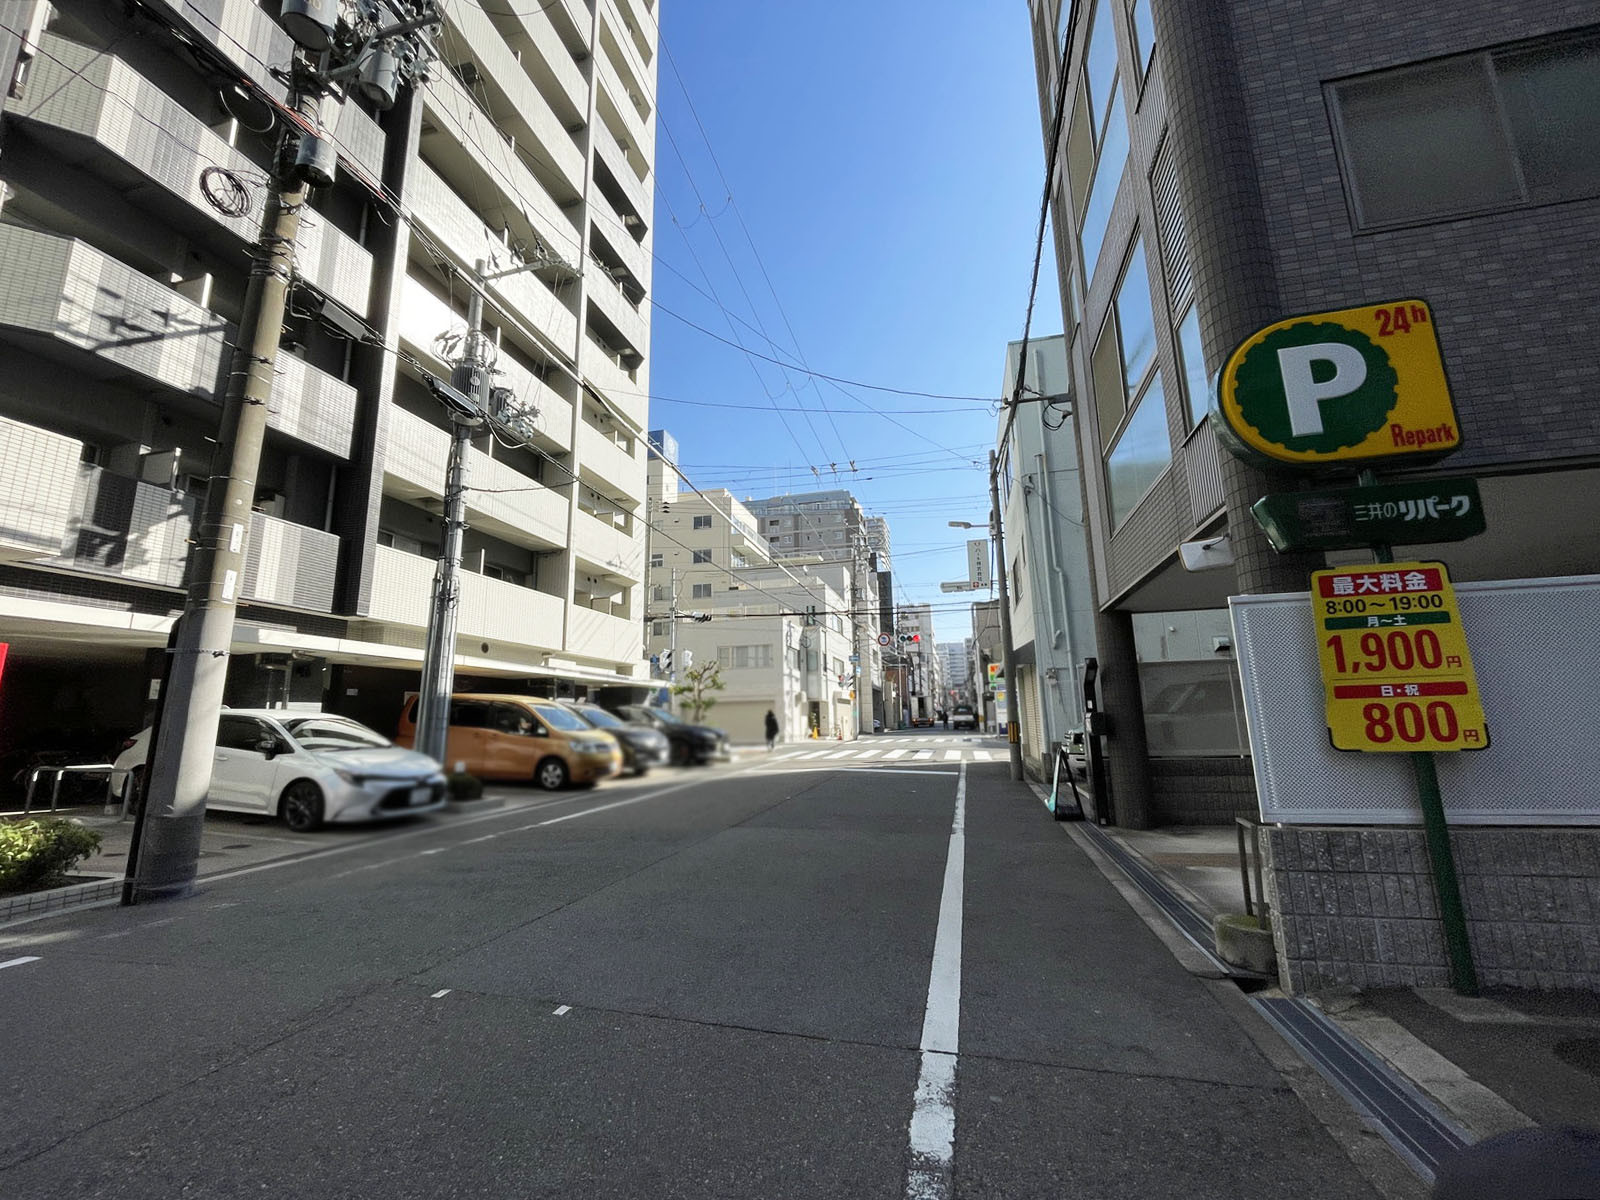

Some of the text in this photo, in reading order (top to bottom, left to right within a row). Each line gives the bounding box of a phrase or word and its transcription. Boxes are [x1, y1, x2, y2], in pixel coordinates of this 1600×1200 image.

[1374, 305, 1428, 337] 24h
[1277, 342, 1367, 437] P
[1390, 423, 1456, 448] Repark
[1354, 496, 1470, 521] 三井のリパーク
[1332, 571, 1428, 595] 最大料金
